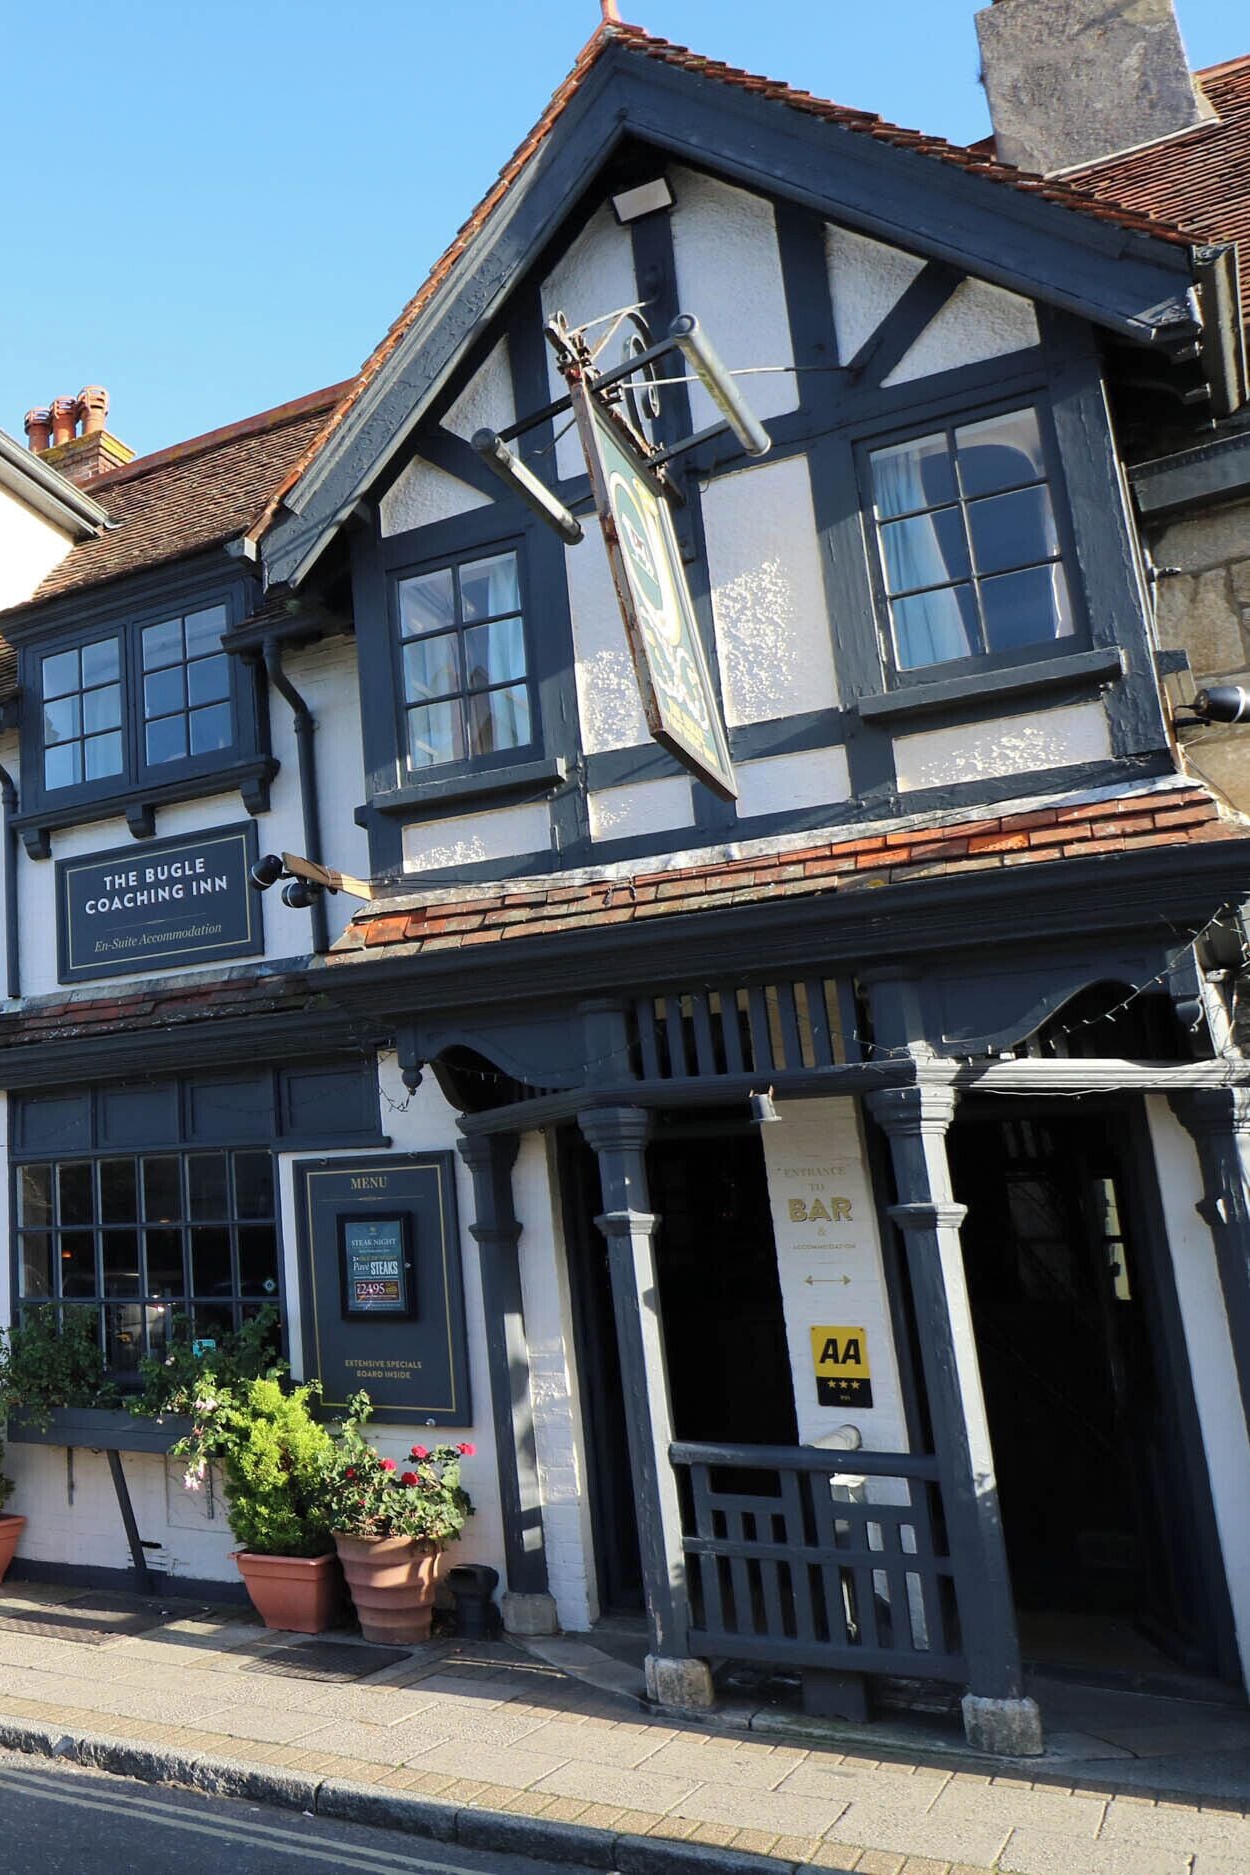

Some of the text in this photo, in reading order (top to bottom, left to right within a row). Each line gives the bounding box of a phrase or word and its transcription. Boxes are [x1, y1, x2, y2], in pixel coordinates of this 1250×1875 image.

[104, 858, 206, 891] THE BUGLE
[85, 875, 228, 914] COACHING INN
[94, 922, 222, 952] En-Suite Accommodation
[350, 1175, 387, 1190] MENU
[788, 1196, 854, 1222] BAR
[351, 1238, 397, 1247] STEAK NIGHT
[370, 1261, 398, 1275] STEAKS
[819, 1338, 862, 1365] AA
[345, 1359, 422, 1369] EXTENSIVE SPECIALS
[356, 1370, 383, 1378] BOARD
